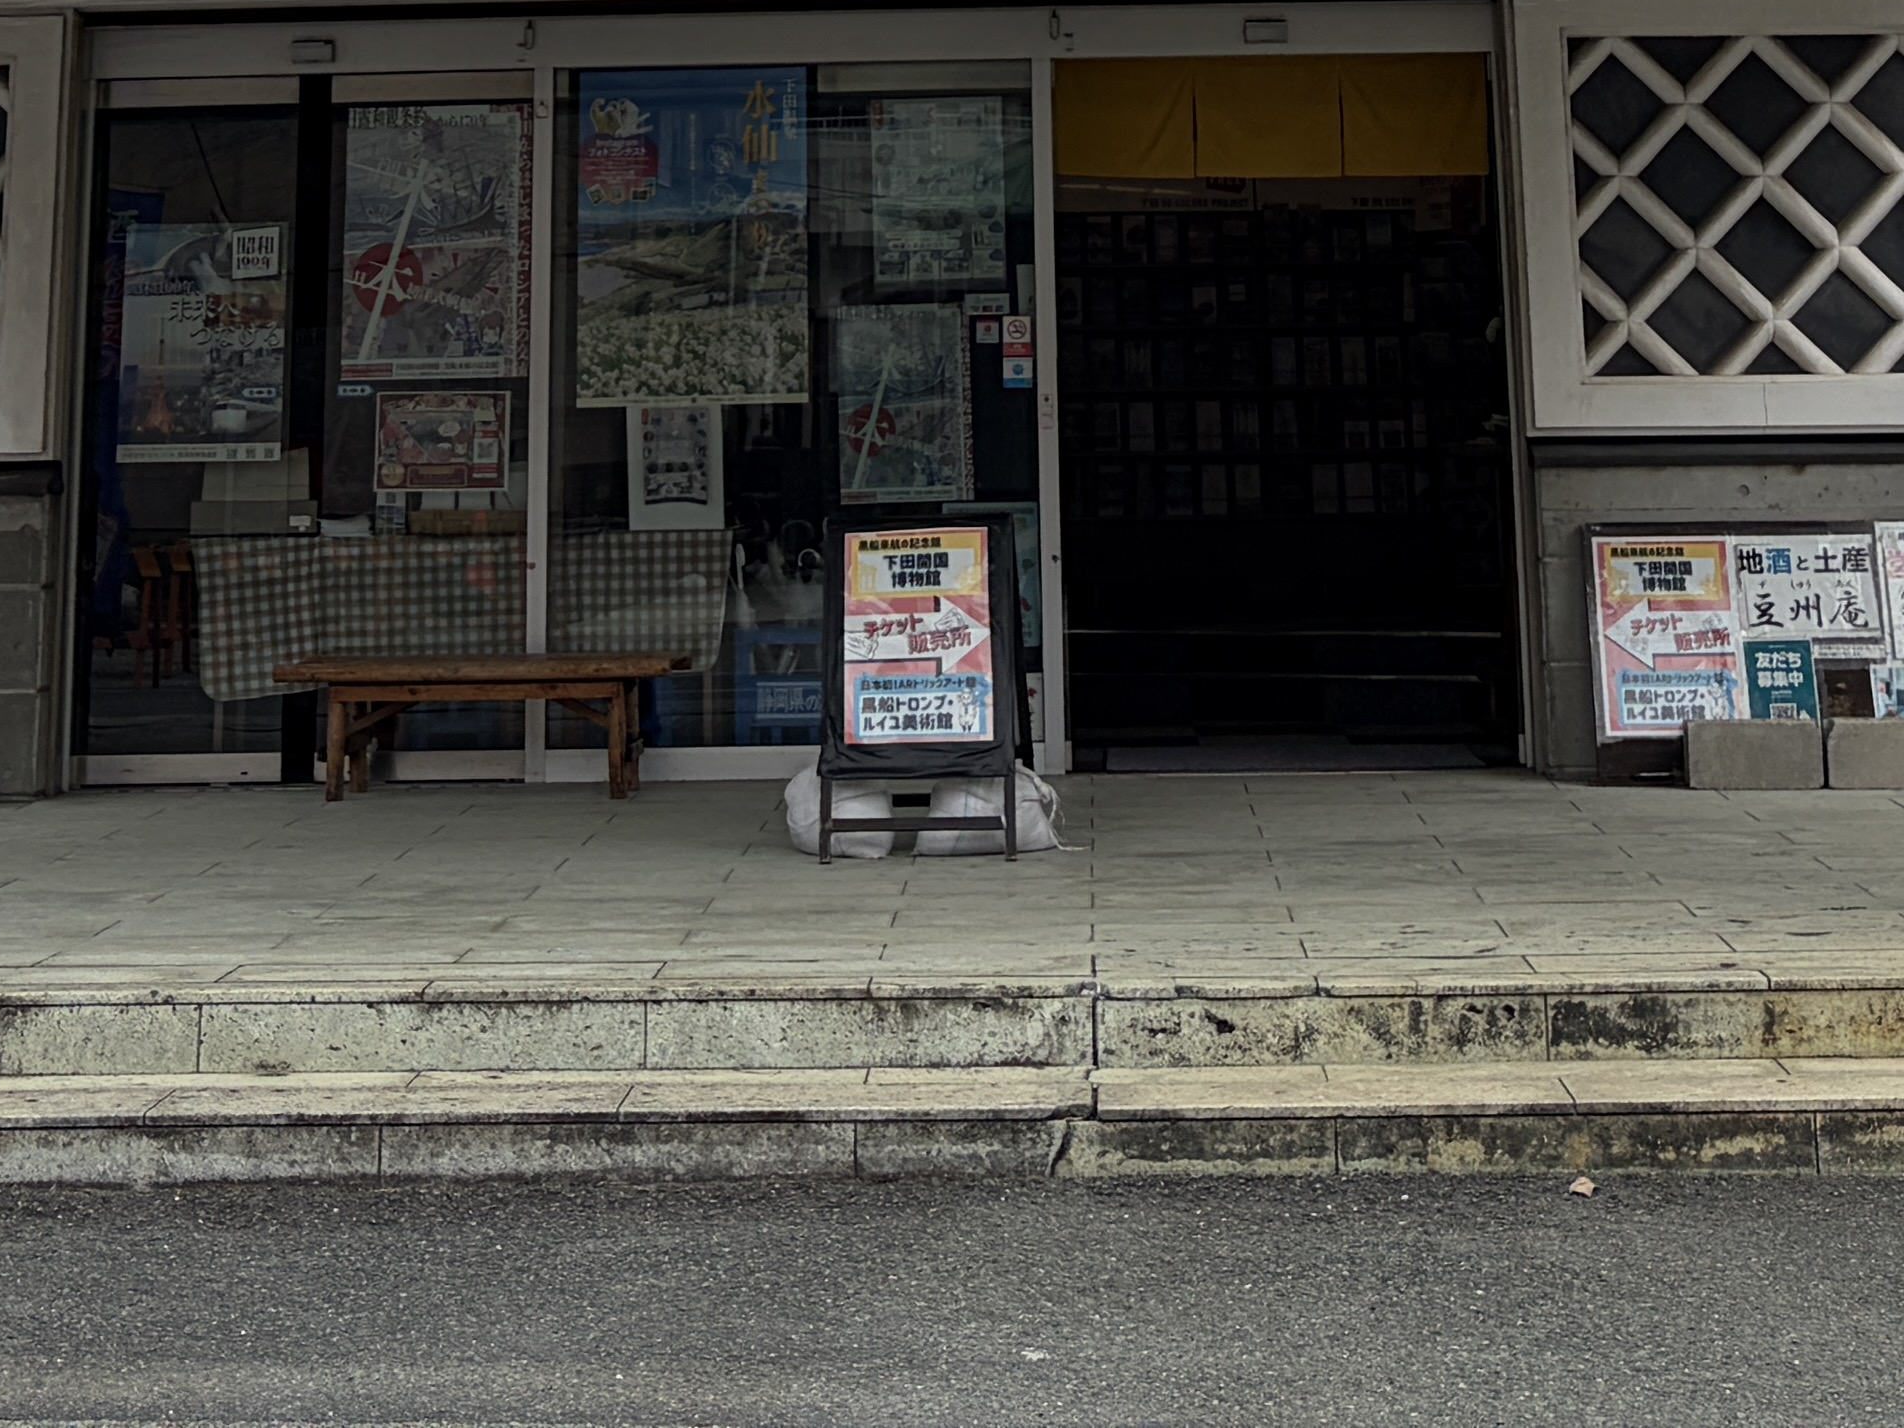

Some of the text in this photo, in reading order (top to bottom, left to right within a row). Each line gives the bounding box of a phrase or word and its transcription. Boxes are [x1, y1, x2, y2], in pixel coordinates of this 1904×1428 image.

[883, 552, 949, 571] 下田開国
[1737, 547, 1869, 575] 地酒と土産
[892, 570, 941, 589] 博物館
[1749, 590, 1869, 628] 豆州庵
[863, 614, 924, 639] チケット
[1630, 614, 1683, 636] チケット
[908, 626, 972, 656] 販売所
[1755, 652, 1802, 668] 友だち
[1757, 671, 1804, 687] 募集中
